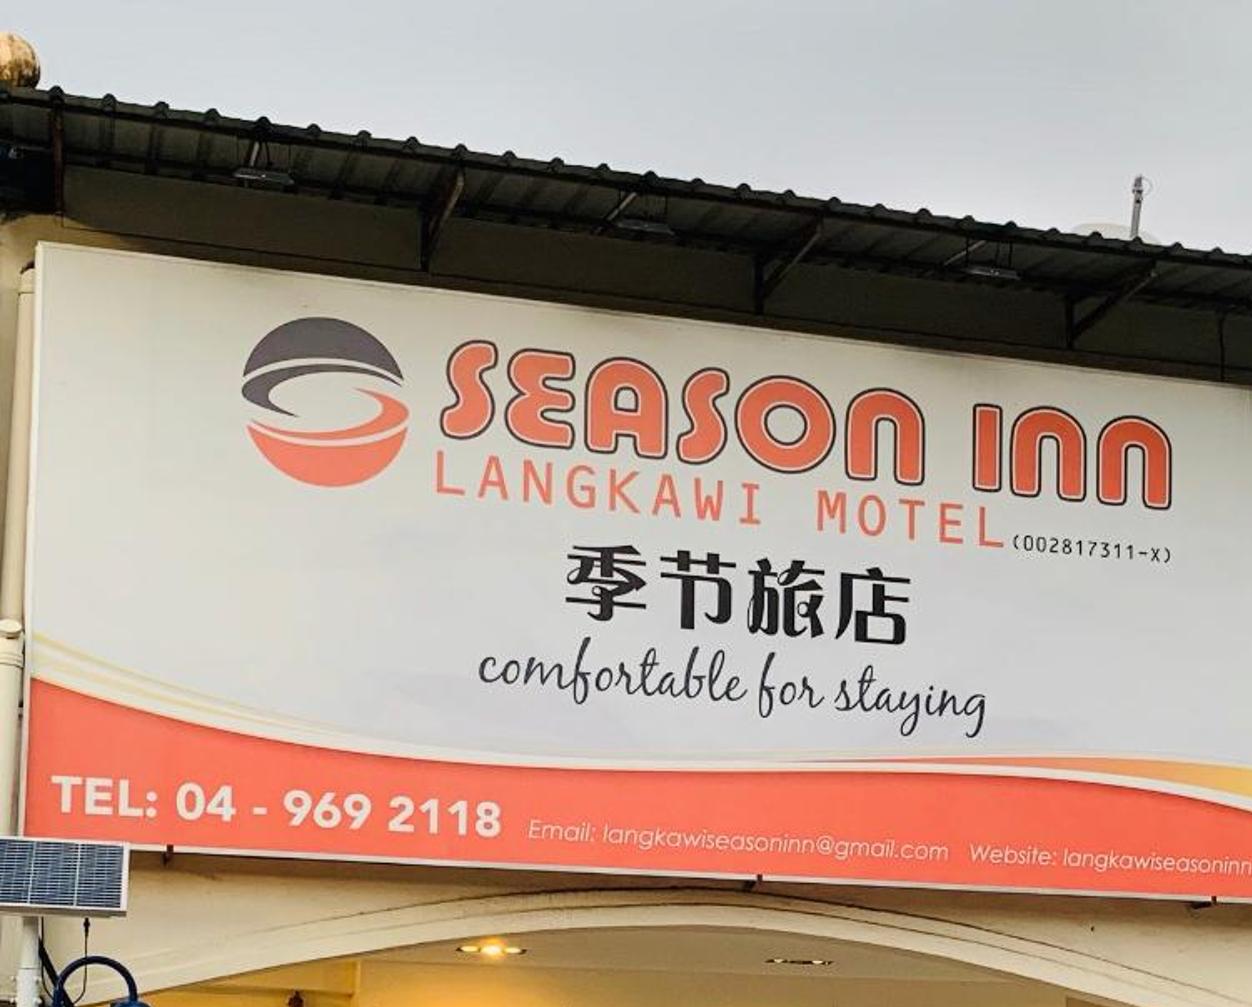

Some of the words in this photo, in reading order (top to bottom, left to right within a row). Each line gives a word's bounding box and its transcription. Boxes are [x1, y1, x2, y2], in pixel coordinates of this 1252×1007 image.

[440, 340, 925, 486] SEASON
[973, 403, 1172, 510] INN
[434, 450, 762, 525] LANGKAWI
[817, 489, 1005, 548] MOTEL
[1013, 534, 1171, 564] (002817311-X)
[566, 545, 911, 646] 季节旅店
[479, 636, 748, 705] comfortable
[758, 651, 825, 719] for
[834, 664, 987, 738] staying
[51, 775, 158, 819] TEL:
[176, 781, 237, 822] 04
[252, 806, 268, 815] -
[282, 788, 374, 833] 969
[388, 794, 501, 838] 2118
[528, 818, 596, 844] Email:
[601, 821, 948, 862] langkawiseasoninn@gmail.com
[970, 843, 1057, 866] Website:
